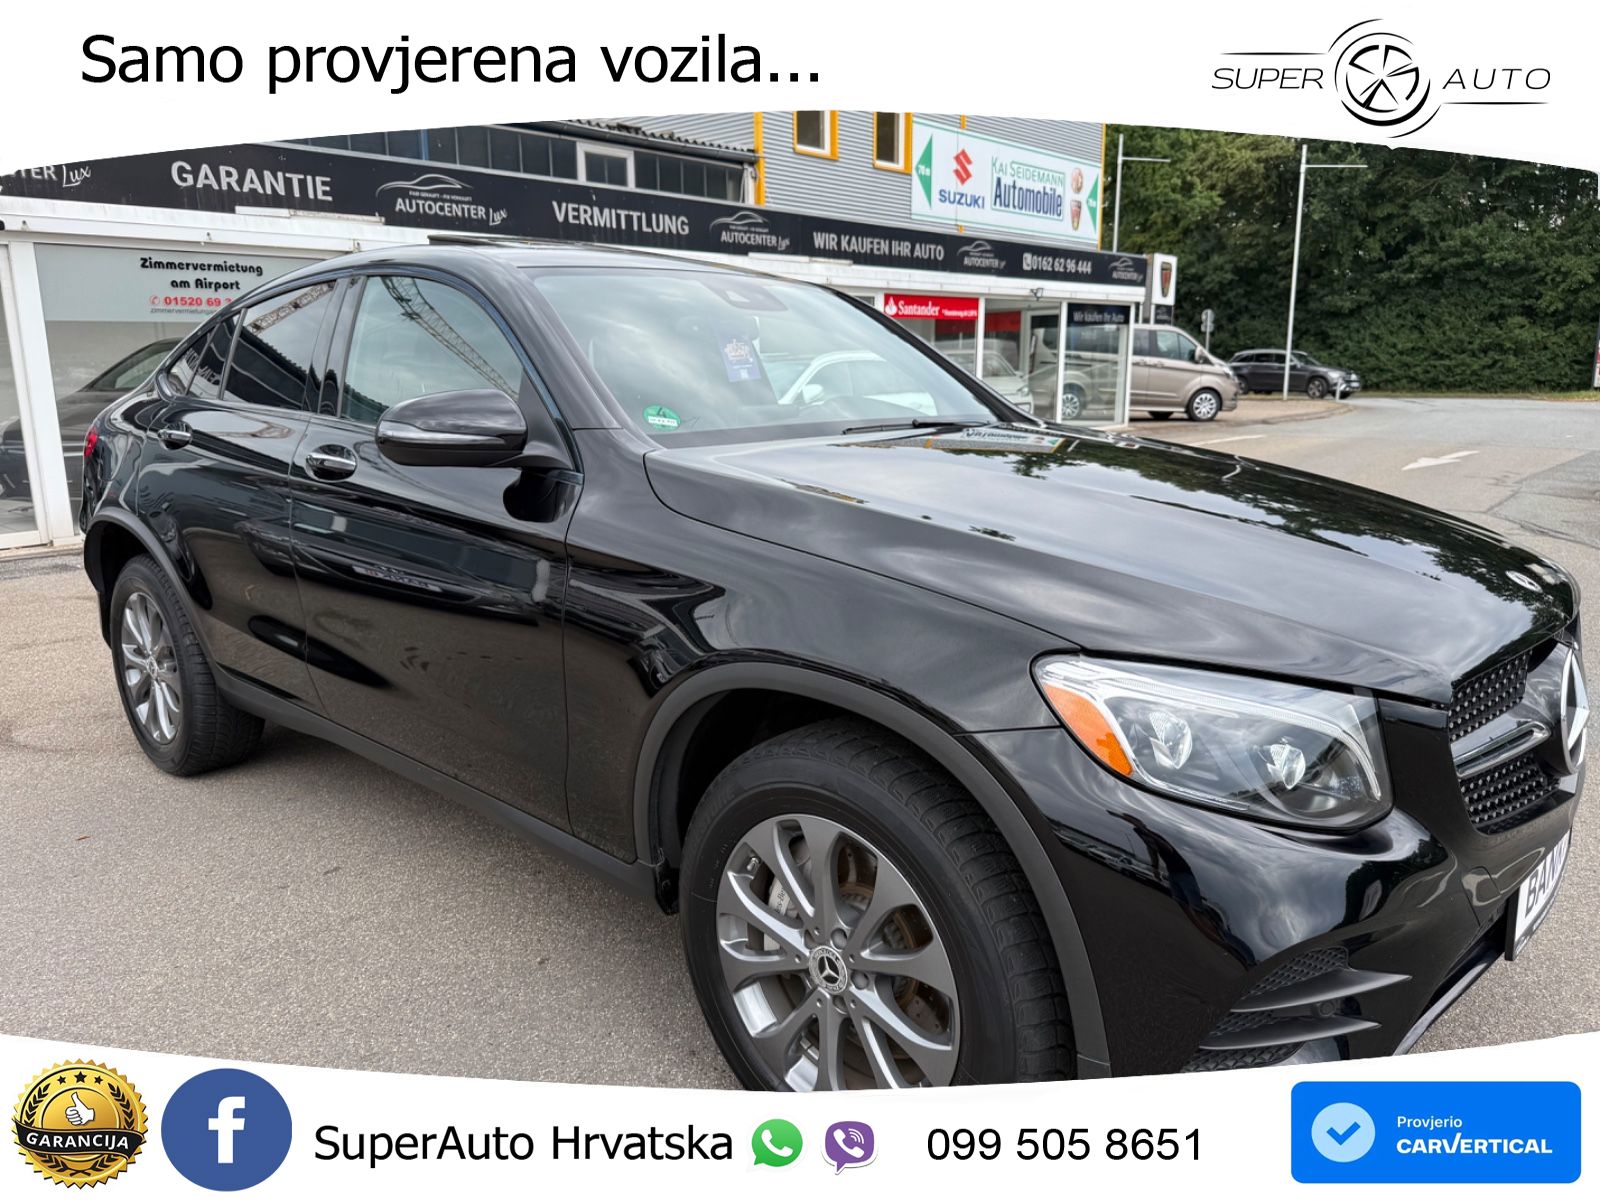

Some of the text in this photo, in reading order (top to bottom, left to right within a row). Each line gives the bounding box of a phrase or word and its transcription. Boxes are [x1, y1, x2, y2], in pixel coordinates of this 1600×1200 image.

[62, 164, 91, 187] Lux
[992, 155, 1008, 177] KAI
[171, 155, 333, 202] GARANTIE
[938, 188, 985, 210] SUZUKI
[993, 176, 1063, 218] Automobile
[395, 198, 487, 220] AUTOCENTER
[552, 200, 690, 235] VERMITTLUNG
[720, 230, 777, 248] AUTOCENTER
[813, 231, 945, 260] WIR KAUFEN IHR AUTO
[140, 257, 263, 277] Zimmervermietung
[1032, 255, 1092, 275] 0162 62 96 444
[170, 278, 241, 292] am Airport
[164, 296, 203, 307] 01520
[206, 297, 221, 307] 69
[898, 300, 940, 316] Santander
